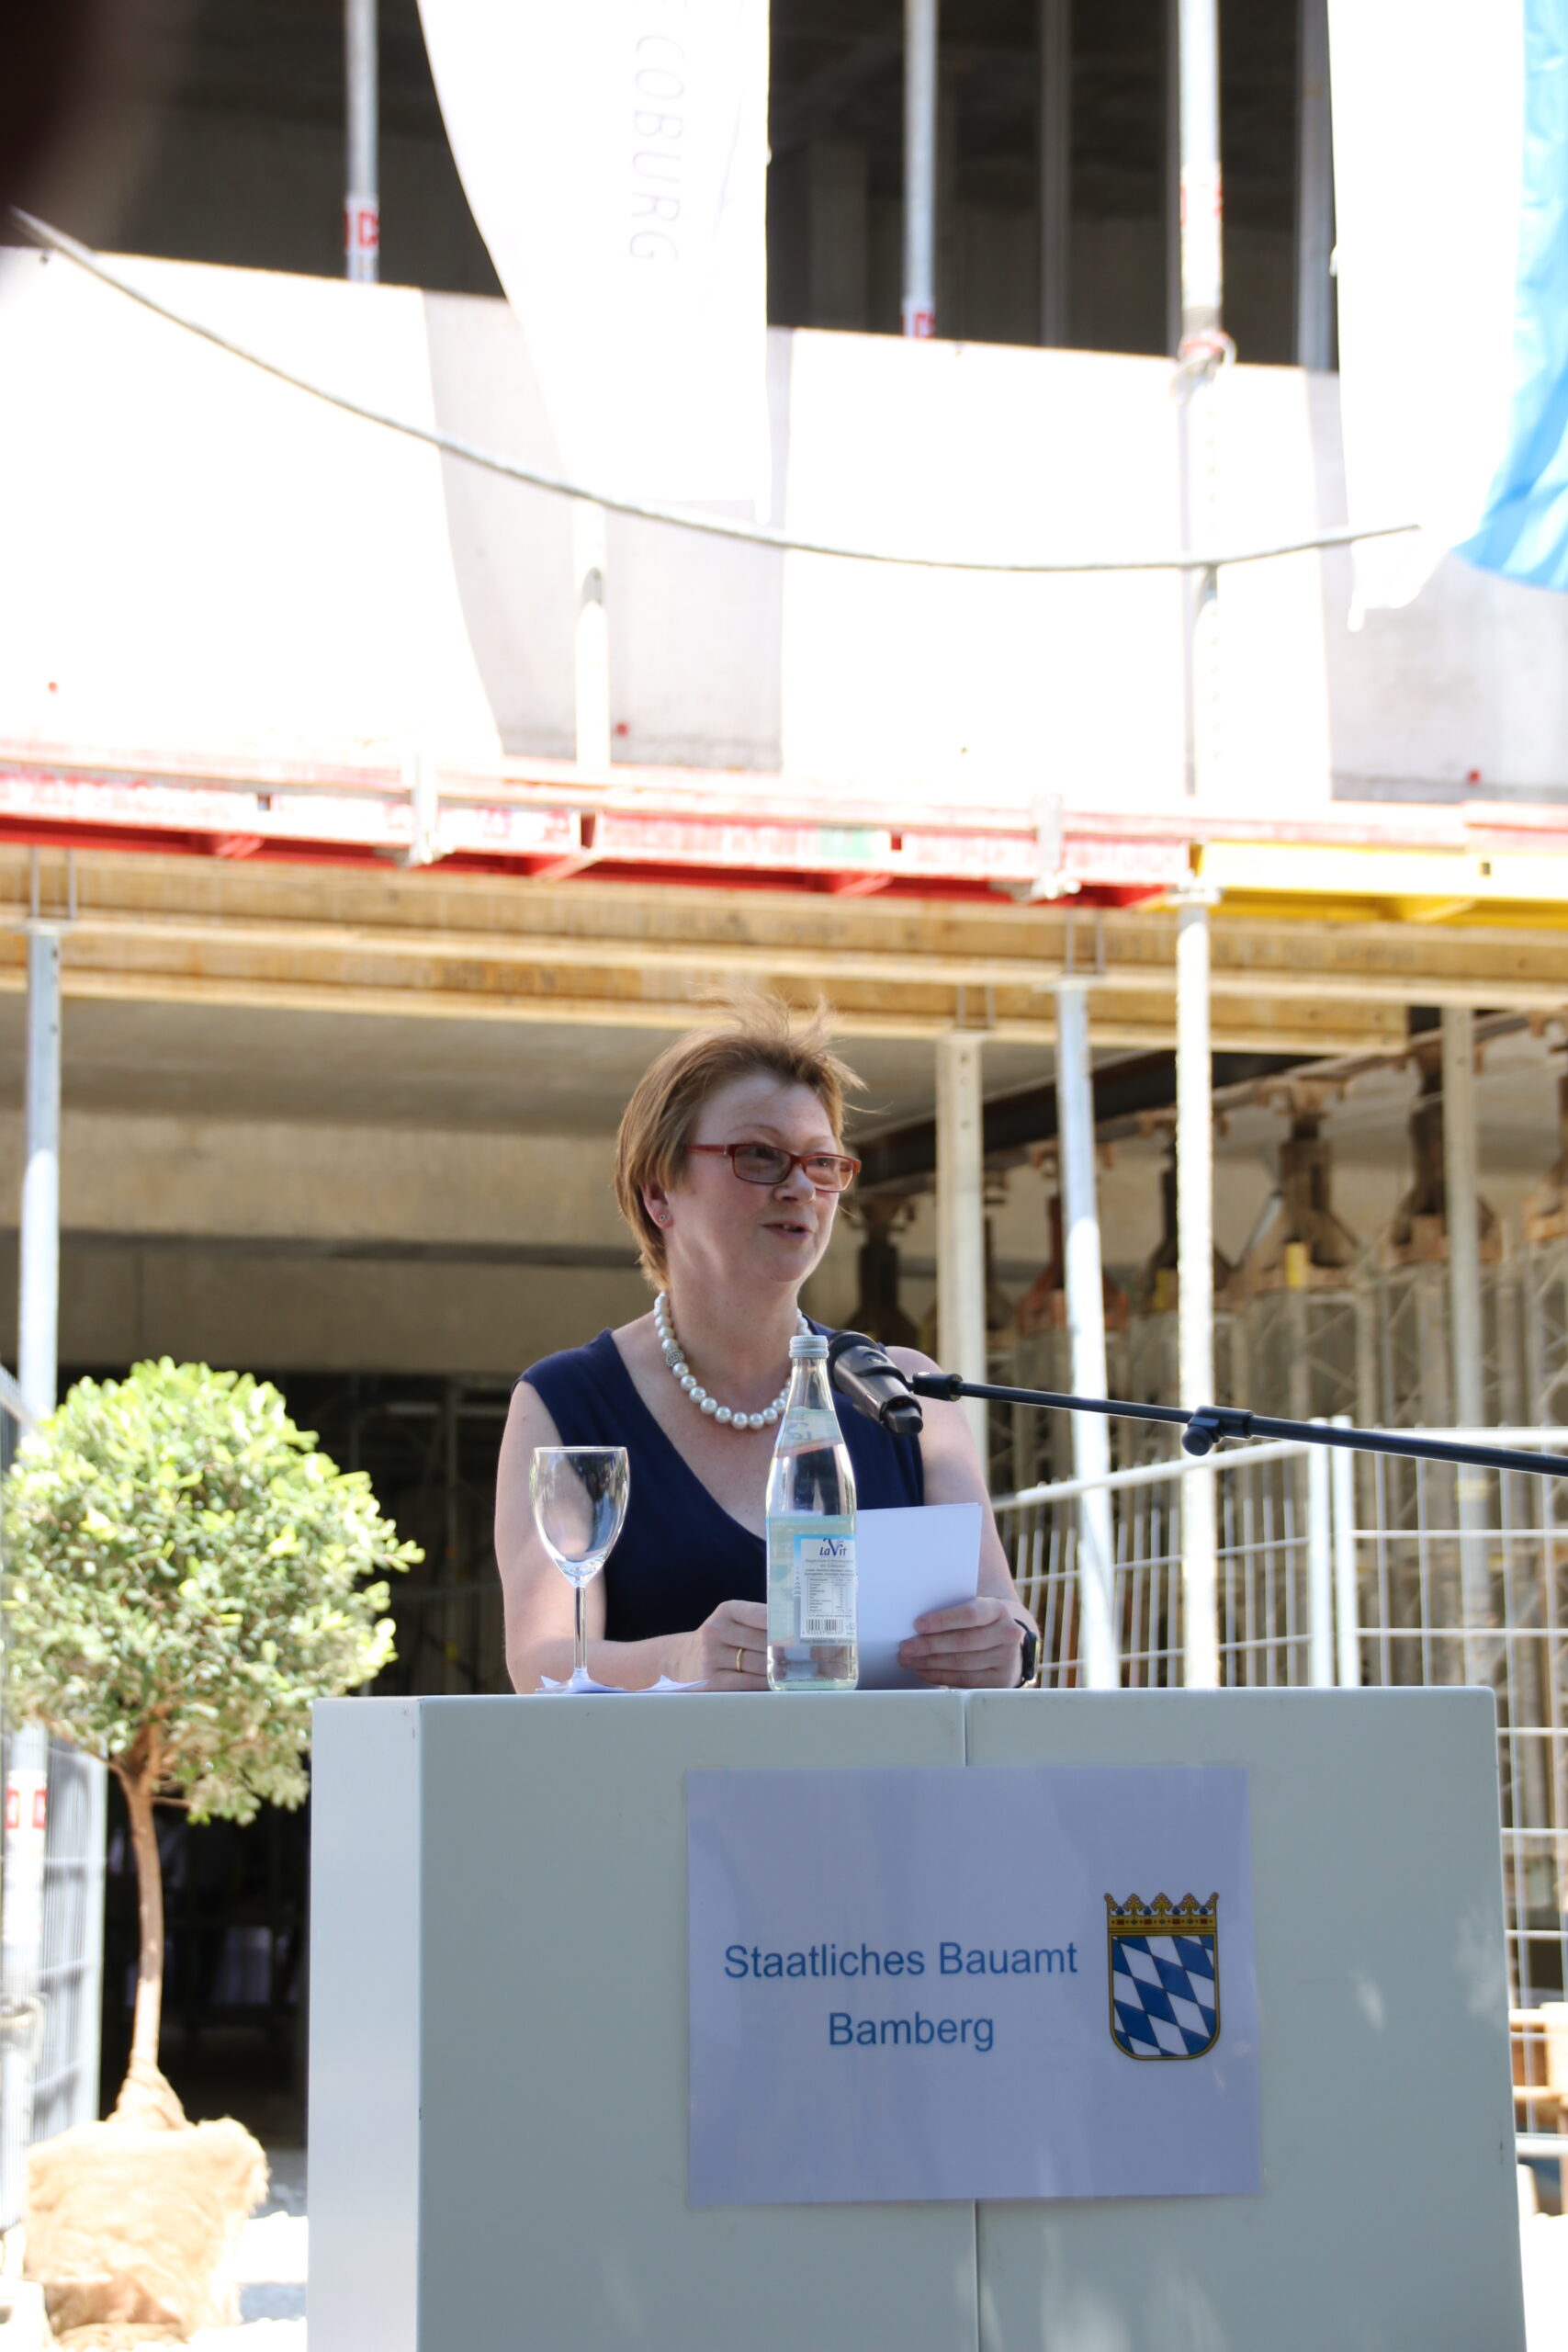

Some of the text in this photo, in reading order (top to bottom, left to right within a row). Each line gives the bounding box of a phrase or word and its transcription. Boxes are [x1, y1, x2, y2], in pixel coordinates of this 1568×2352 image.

[629, 34, 685, 261] COBURG
[725, 1941, 1078, 1979] Staatliches Bauamt
[829, 2011, 995, 2052] Bamberg
